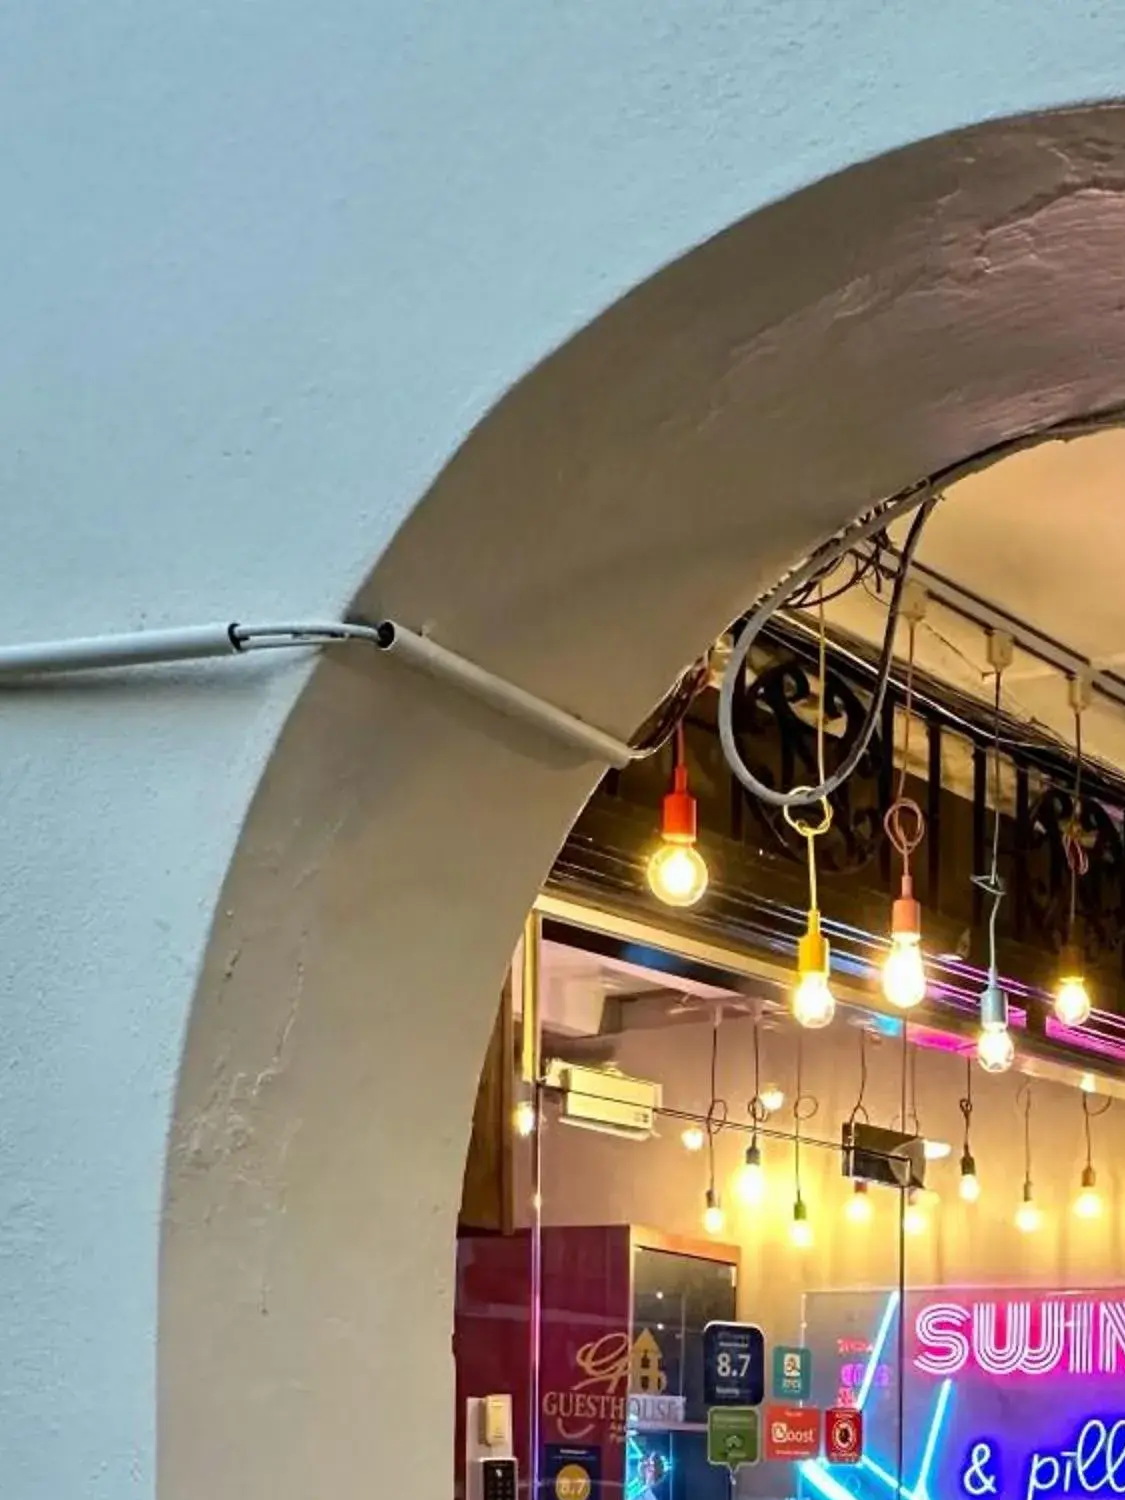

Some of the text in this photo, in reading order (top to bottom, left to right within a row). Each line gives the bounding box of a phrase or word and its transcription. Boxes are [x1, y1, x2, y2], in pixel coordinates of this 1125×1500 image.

[716, 1352, 751, 1378] 8.7
[963, 1443, 998, 1495] &
[560, 1477, 587, 1495] 8.7
